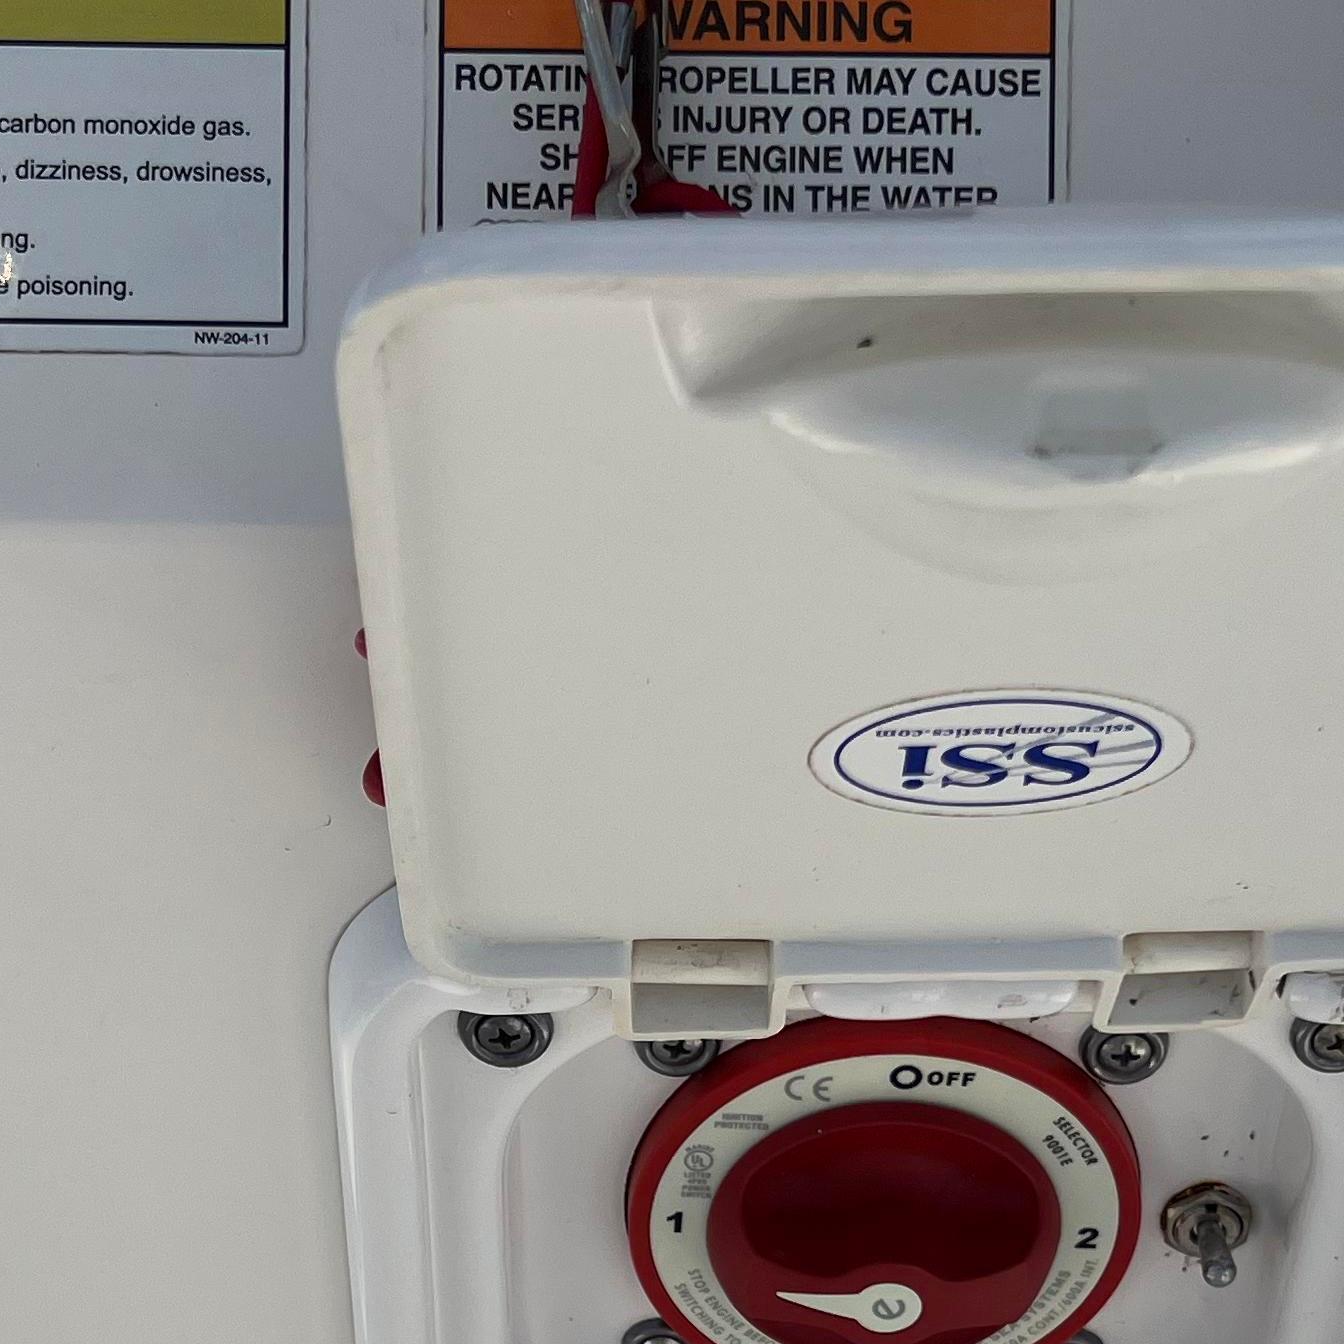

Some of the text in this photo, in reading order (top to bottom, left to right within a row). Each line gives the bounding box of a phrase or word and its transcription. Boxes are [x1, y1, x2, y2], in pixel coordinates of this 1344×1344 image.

[455, 64, 1041, 97] ROTATIN ROPELLER MAY CAUSE
[84, 115, 195, 135] monoxide
[203, 120, 250, 141] gas.
[673, 105, 793, 134] INJURY
[802, 106, 851, 134] OR
[862, 107, 982, 136] DEATH.
[15, 159, 128, 184] dizziness,
[136, 161, 271, 186] drowsiness,
[658, 145, 706, 173] FF
[717, 145, 843, 174] ENGINE
[853, 146, 954, 175] WHEN
[763, 185, 794, 213] IN
[804, 185, 870, 213] THE
[17, 275, 133, 301] poisoning.
[195, 331, 268, 345] NW-204-11
[875, 723, 1134, 739] ssicustomplastics.com
[784, 1075, 833, 1101] CE
[927, 1071, 976, 1087] OFF
[1042, 1135, 1073, 1167] 9001E
[1053, 1116, 1098, 1166] SELECTOR
[666, 1211, 685, 1233] 1
[1074, 1227, 1101, 1249] 2
[674, 1283, 725, 1336] SWITCHING
[687, 1268, 711, 1294] STOP
[704, 1295, 745, 1331] ENGINE
